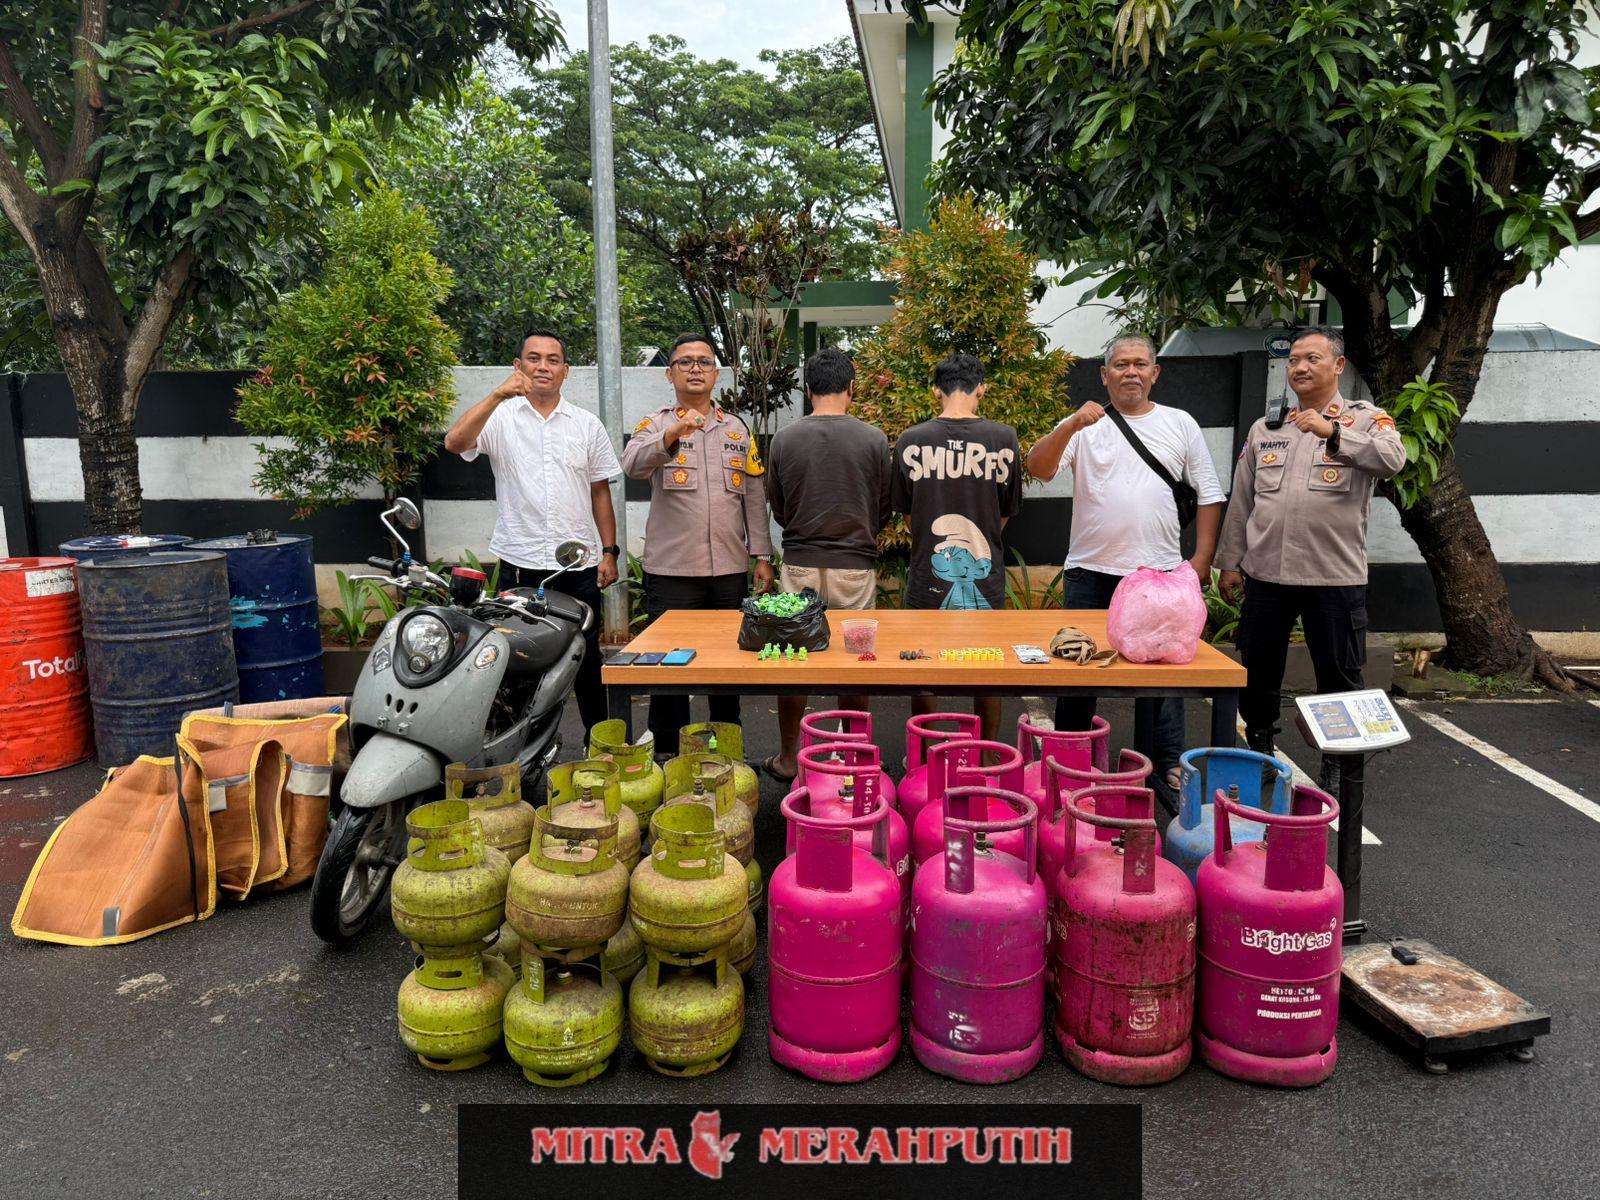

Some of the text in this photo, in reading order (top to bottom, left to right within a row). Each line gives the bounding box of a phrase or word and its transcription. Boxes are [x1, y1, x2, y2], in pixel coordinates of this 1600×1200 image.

[946, 439, 964, 451] THE
[1260, 440, 1289, 450] WAHYU
[902, 442, 1015, 483] SMURFS
[1302, 931, 1332, 951] Gas
[1257, 1009, 1290, 1019] PRODUKSI
